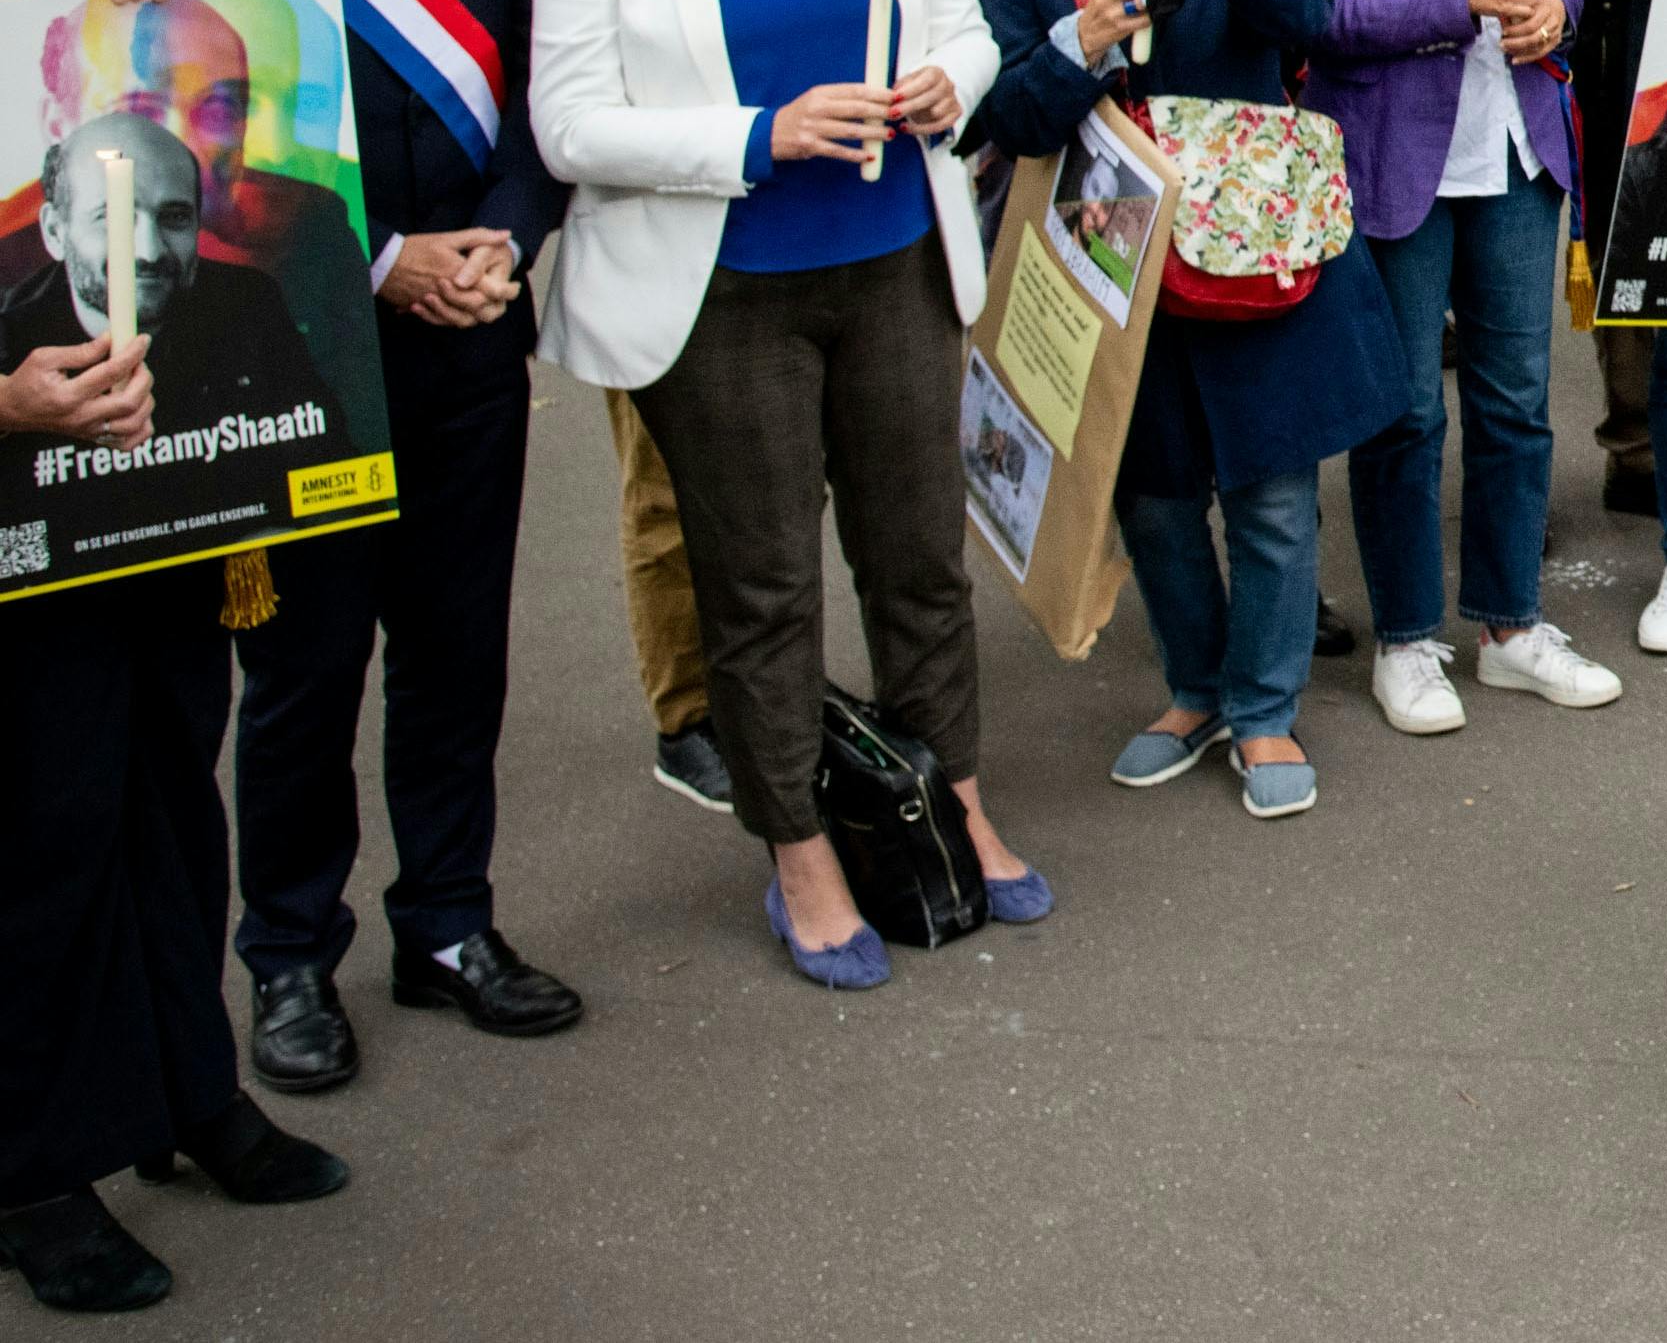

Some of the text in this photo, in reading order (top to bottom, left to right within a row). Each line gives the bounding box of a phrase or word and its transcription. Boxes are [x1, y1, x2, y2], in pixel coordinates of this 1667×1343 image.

[34, 401, 327, 488] #FreeRamyShaath
[302, 470, 357, 493] AMNESTY
[73, 539, 89, 553] ON
[89, 536, 103, 550] SE
